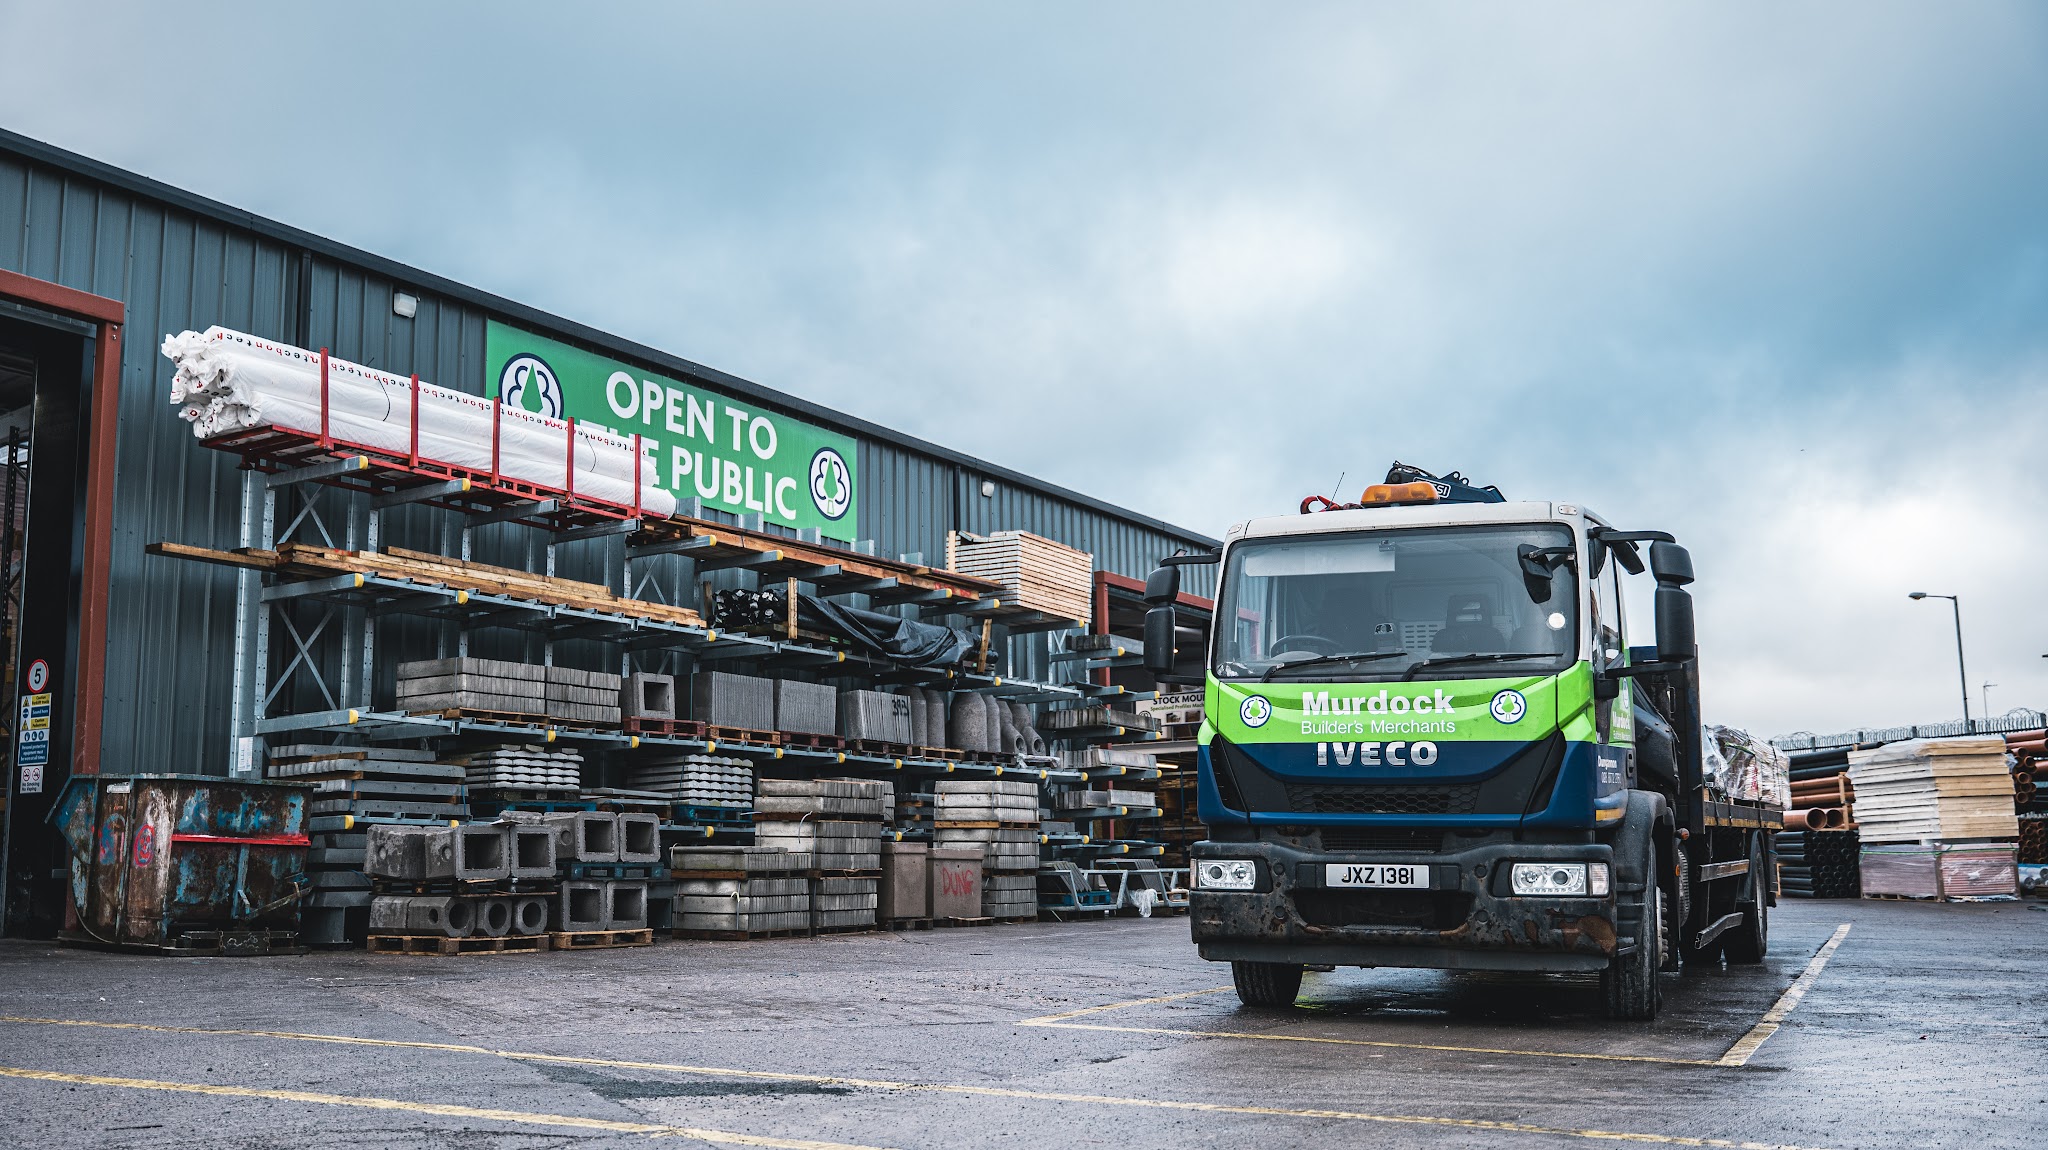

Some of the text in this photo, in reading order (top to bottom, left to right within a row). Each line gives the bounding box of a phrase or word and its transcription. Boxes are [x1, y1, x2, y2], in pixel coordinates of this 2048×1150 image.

[606, 371, 715, 445] OPEN
[725, 405, 777, 460] TO
[672, 448, 798, 521] PUBLIC
[34, 667, 42, 685] 5
[1153, 693, 1205, 705] STOCK MOU
[1302, 688, 1456, 716] Murdock
[1301, 719, 1456, 735] Builder's Merchants
[1316, 740, 1439, 767] IVECO
[942, 866, 974, 897] DUNG
[1341, 867, 1414, 885] JXZ 1381
